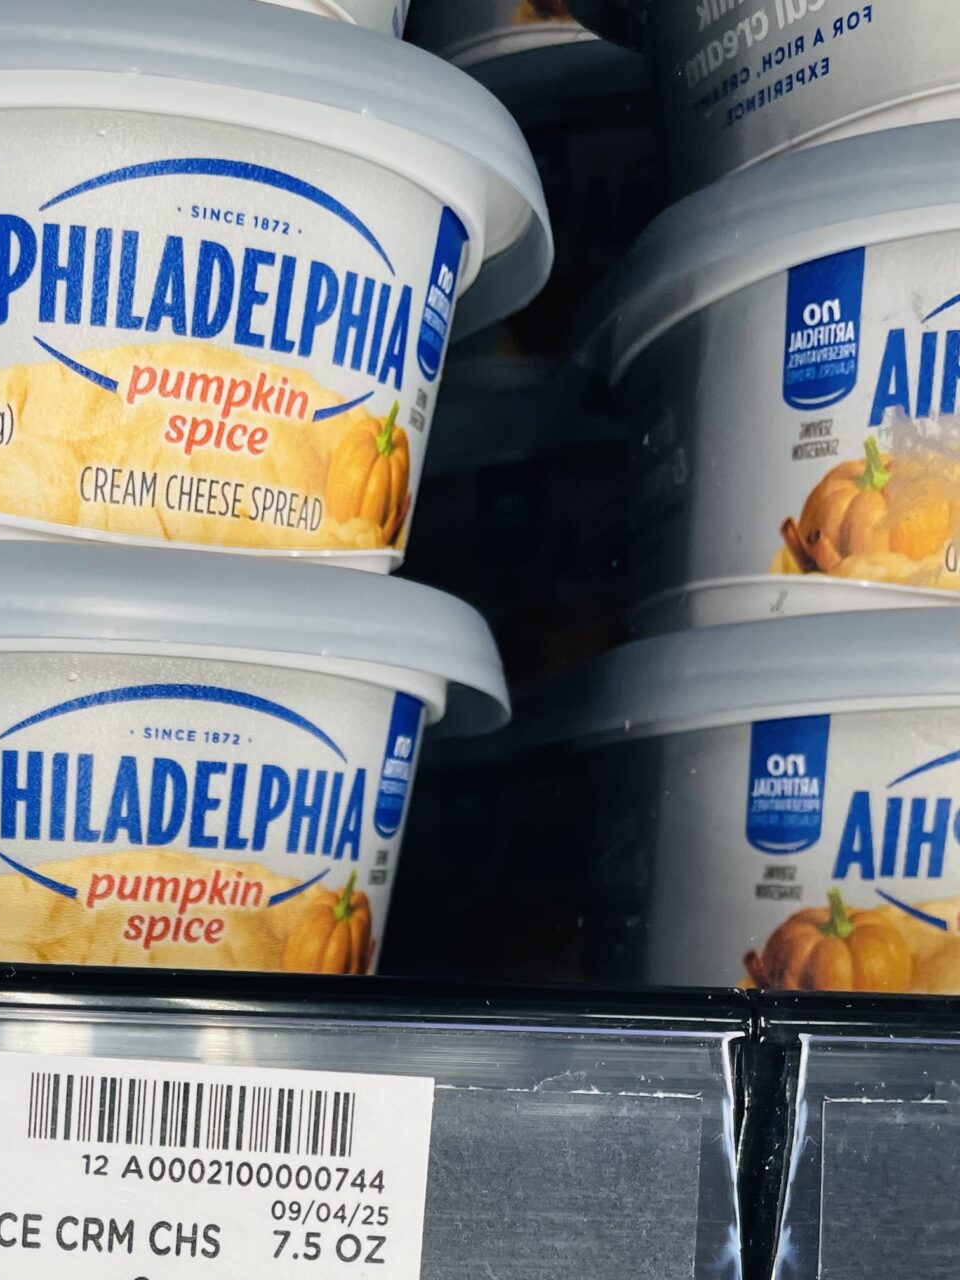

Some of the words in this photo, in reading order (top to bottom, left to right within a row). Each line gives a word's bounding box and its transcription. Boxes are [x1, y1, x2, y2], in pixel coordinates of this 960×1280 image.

[191, 204, 246, 229] SINCE
[252, 215, 291, 236] 1872
[127, 362, 309, 422] pumpkin
[165, 411, 270, 458] spice
[80, 466, 157, 511] CREAM
[166, 475, 242, 520] CHEESE
[247, 487, 323, 532] SPREAD
[142, 727, 197, 745] SINCE
[204, 731, 241, 746] 1872
[86, 869, 265, 910] pumpkin
[122, 908, 225, 949] spice
[82, 1153, 109, 1178] 12
[120, 1154, 386, 1195] A0002100000744
[270, 1199, 390, 1228] 09/04/25
[55, 1216, 136, 1256] CRM
[148, 1221, 222, 1260] CHS
[271, 1231, 322, 1263] 7.5
[334, 1232, 387, 1267] OZ
